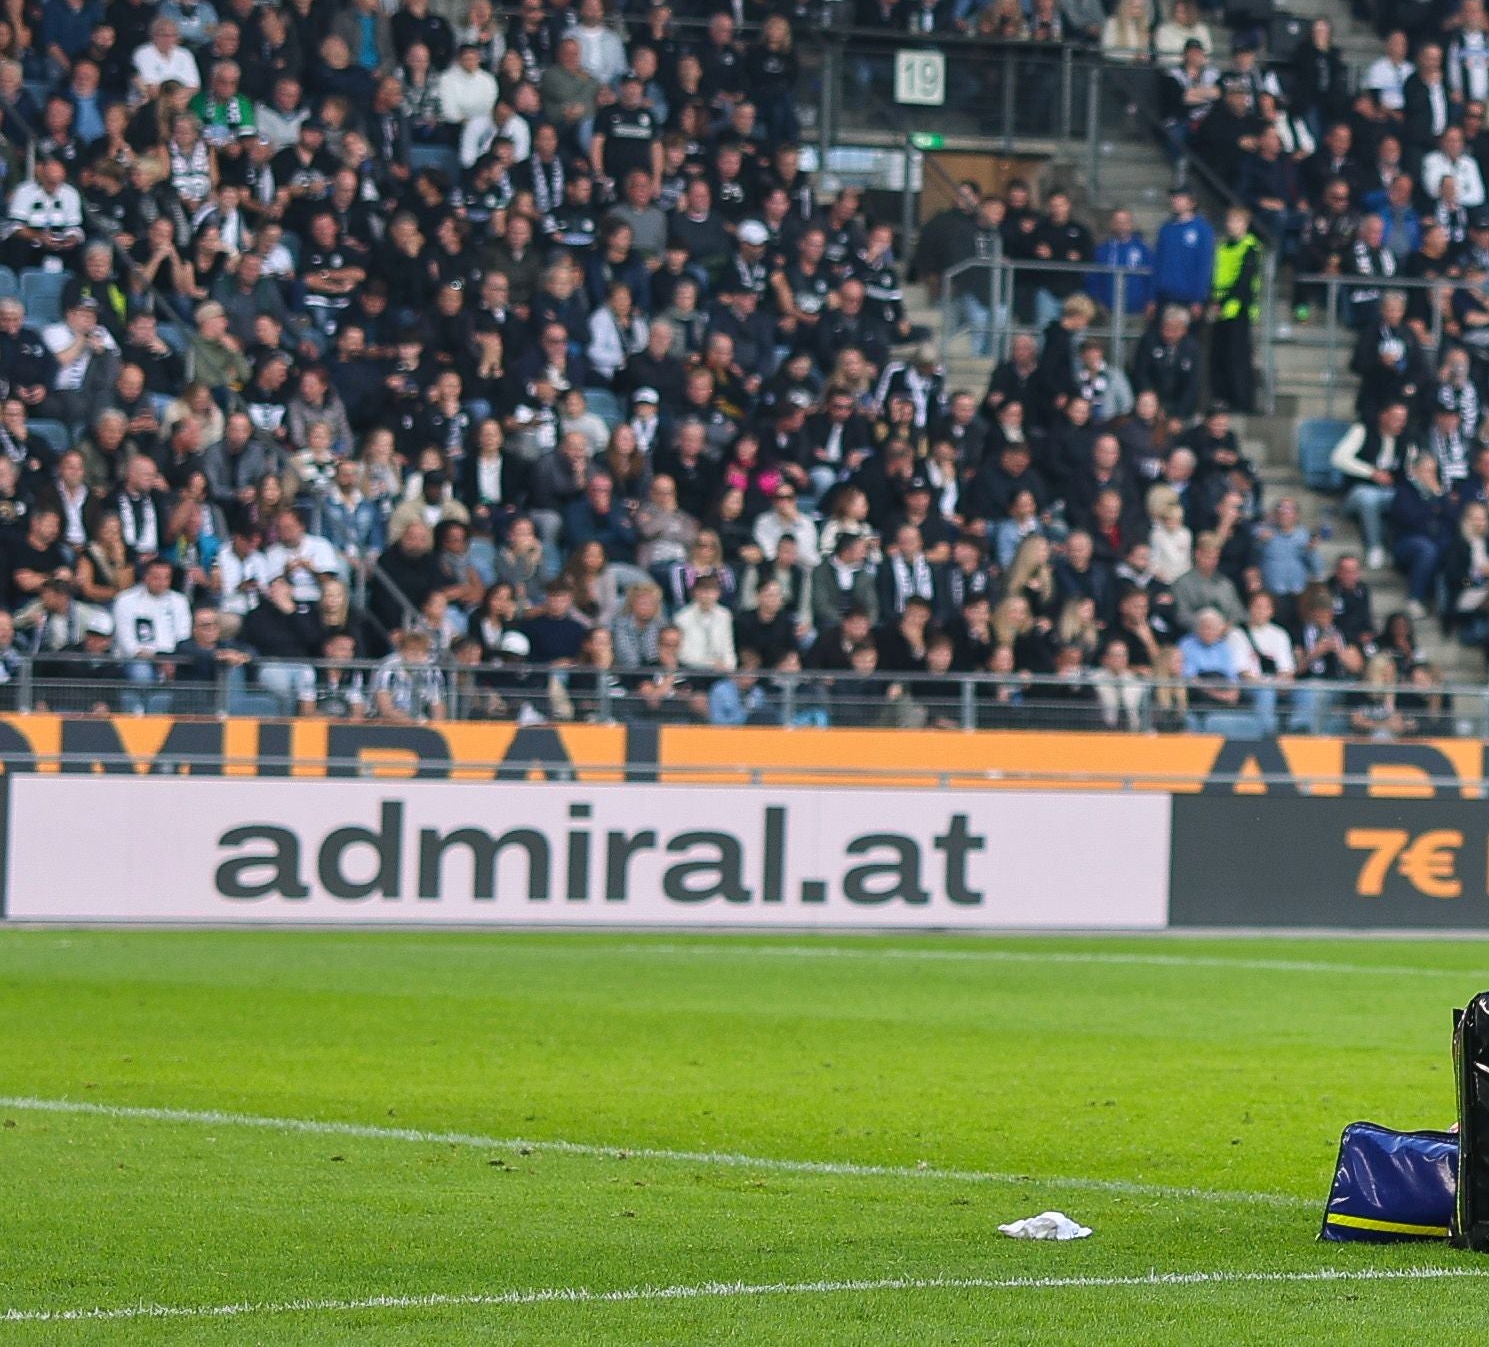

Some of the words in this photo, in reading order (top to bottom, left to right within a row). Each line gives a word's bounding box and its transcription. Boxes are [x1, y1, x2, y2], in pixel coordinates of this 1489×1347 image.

[904, 59, 938, 97] 19
[0, 719, 660, 783] MIRA
[214, 799, 985, 906] admiral.at
[1345, 827, 1464, 899] 7€
